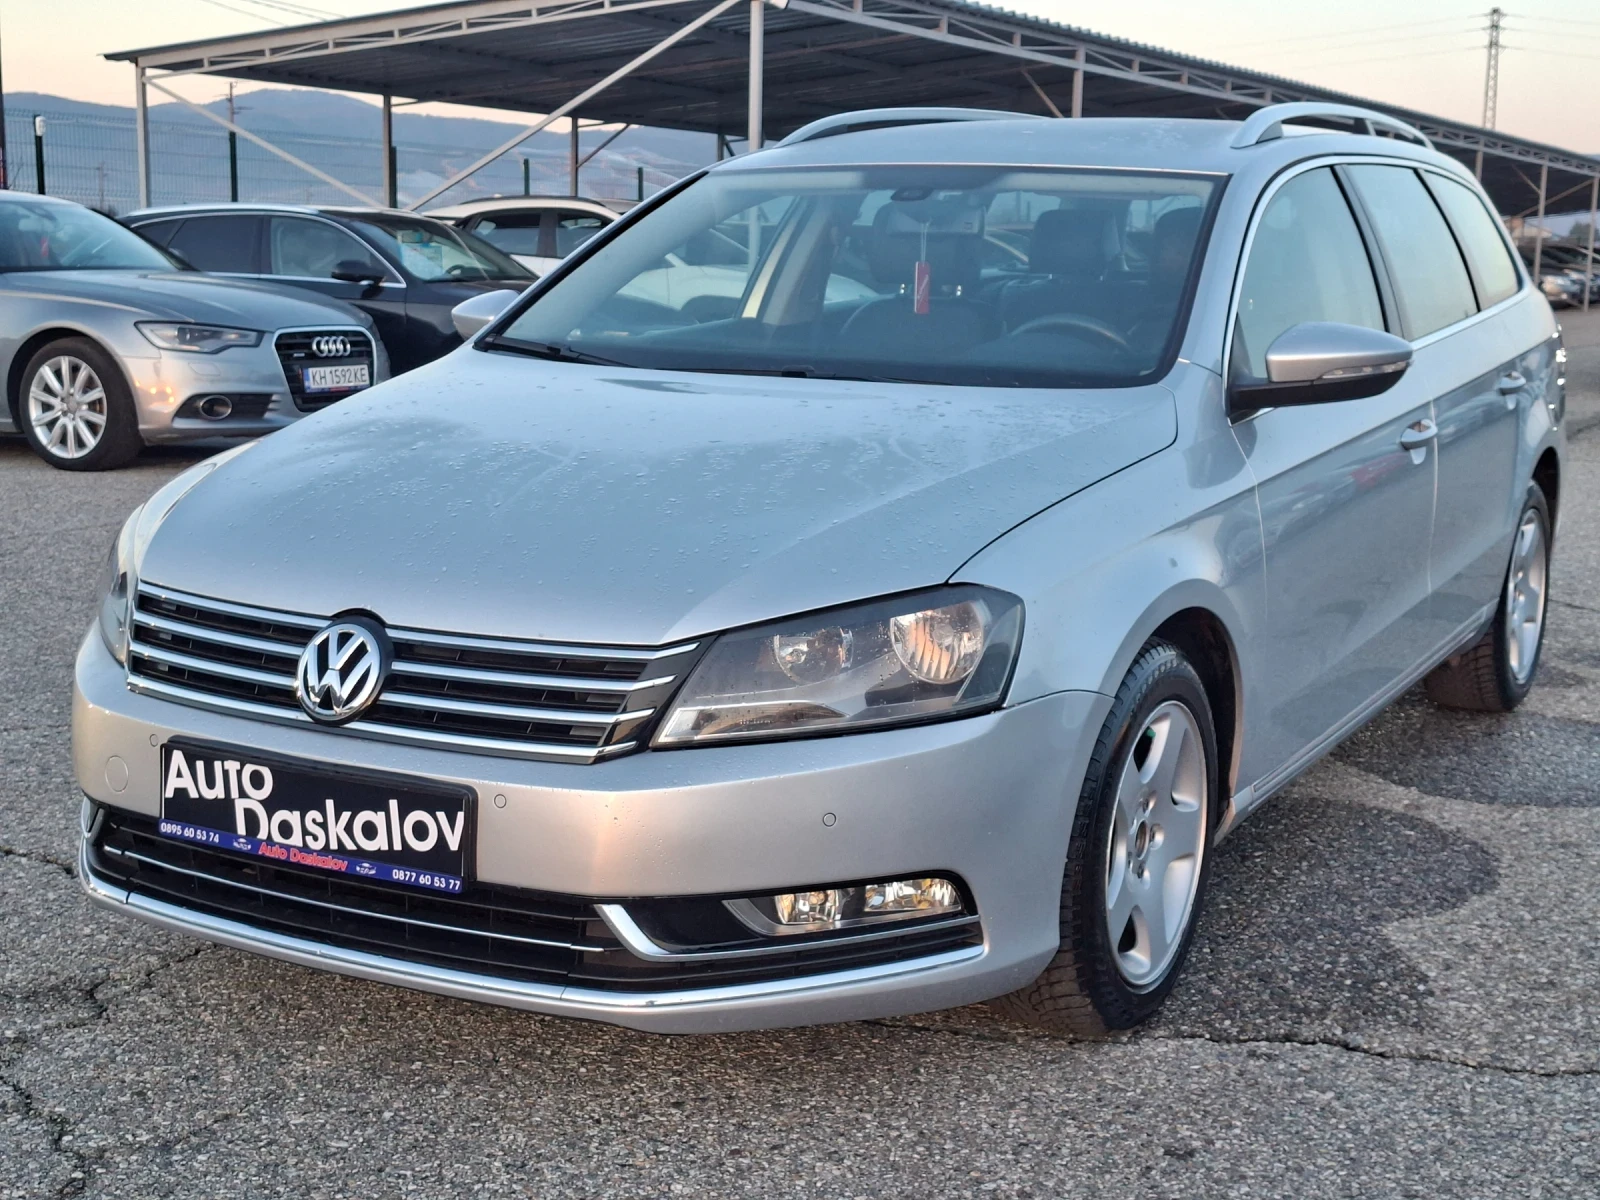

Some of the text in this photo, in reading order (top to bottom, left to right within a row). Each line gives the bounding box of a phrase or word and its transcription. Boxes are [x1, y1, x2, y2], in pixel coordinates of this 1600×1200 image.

[311, 367, 367, 386] KH 1592 KE
[160, 822, 220, 843] 0895 60 53 74
[234, 797, 465, 852] Daskalov
[258, 841, 348, 871] Auto Daskalov
[392, 869, 461, 891] 0877 60 53 77
